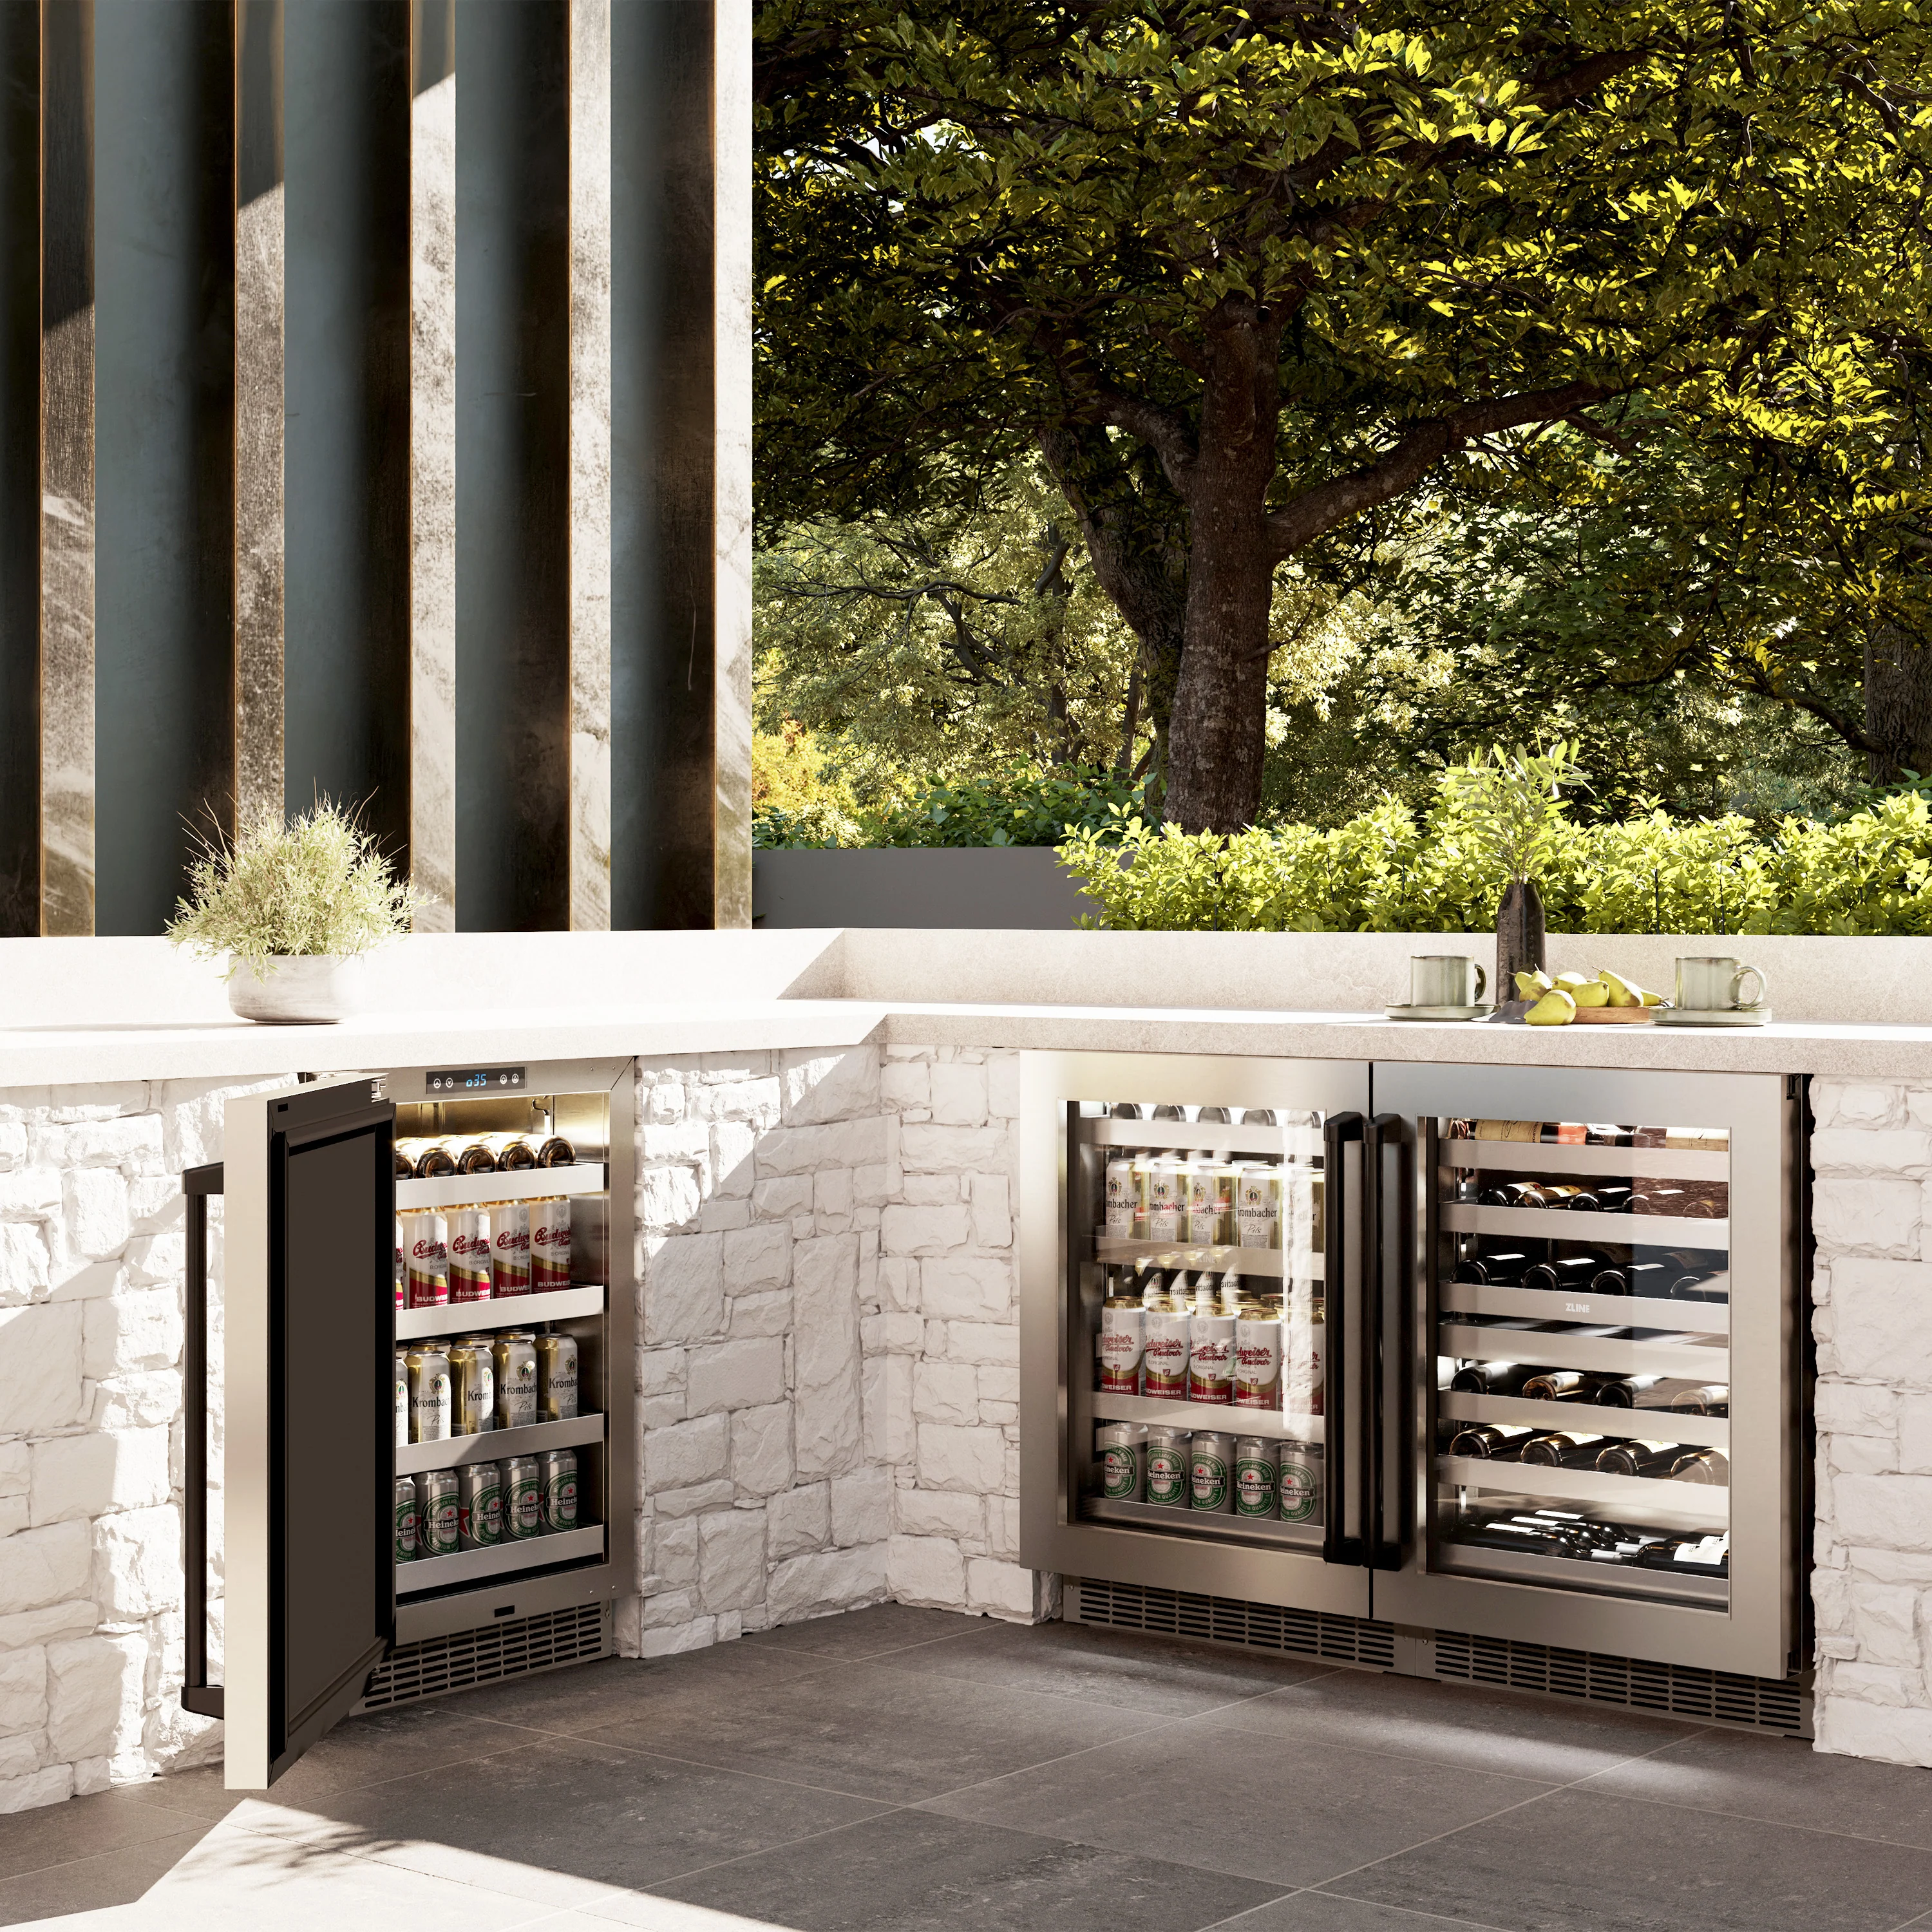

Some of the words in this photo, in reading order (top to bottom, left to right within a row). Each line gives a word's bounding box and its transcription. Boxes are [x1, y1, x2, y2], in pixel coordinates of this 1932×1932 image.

[1108, 1214, 1122, 1224] Pils
[1155, 1218, 1170, 1227] Pils
[1194, 1220, 1206, 1230] Pils
[1244, 1224, 1262, 1235] Pils
[1565, 1303, 1590, 1313] ZLINE
[515, 1401, 533, 1414] Pils
